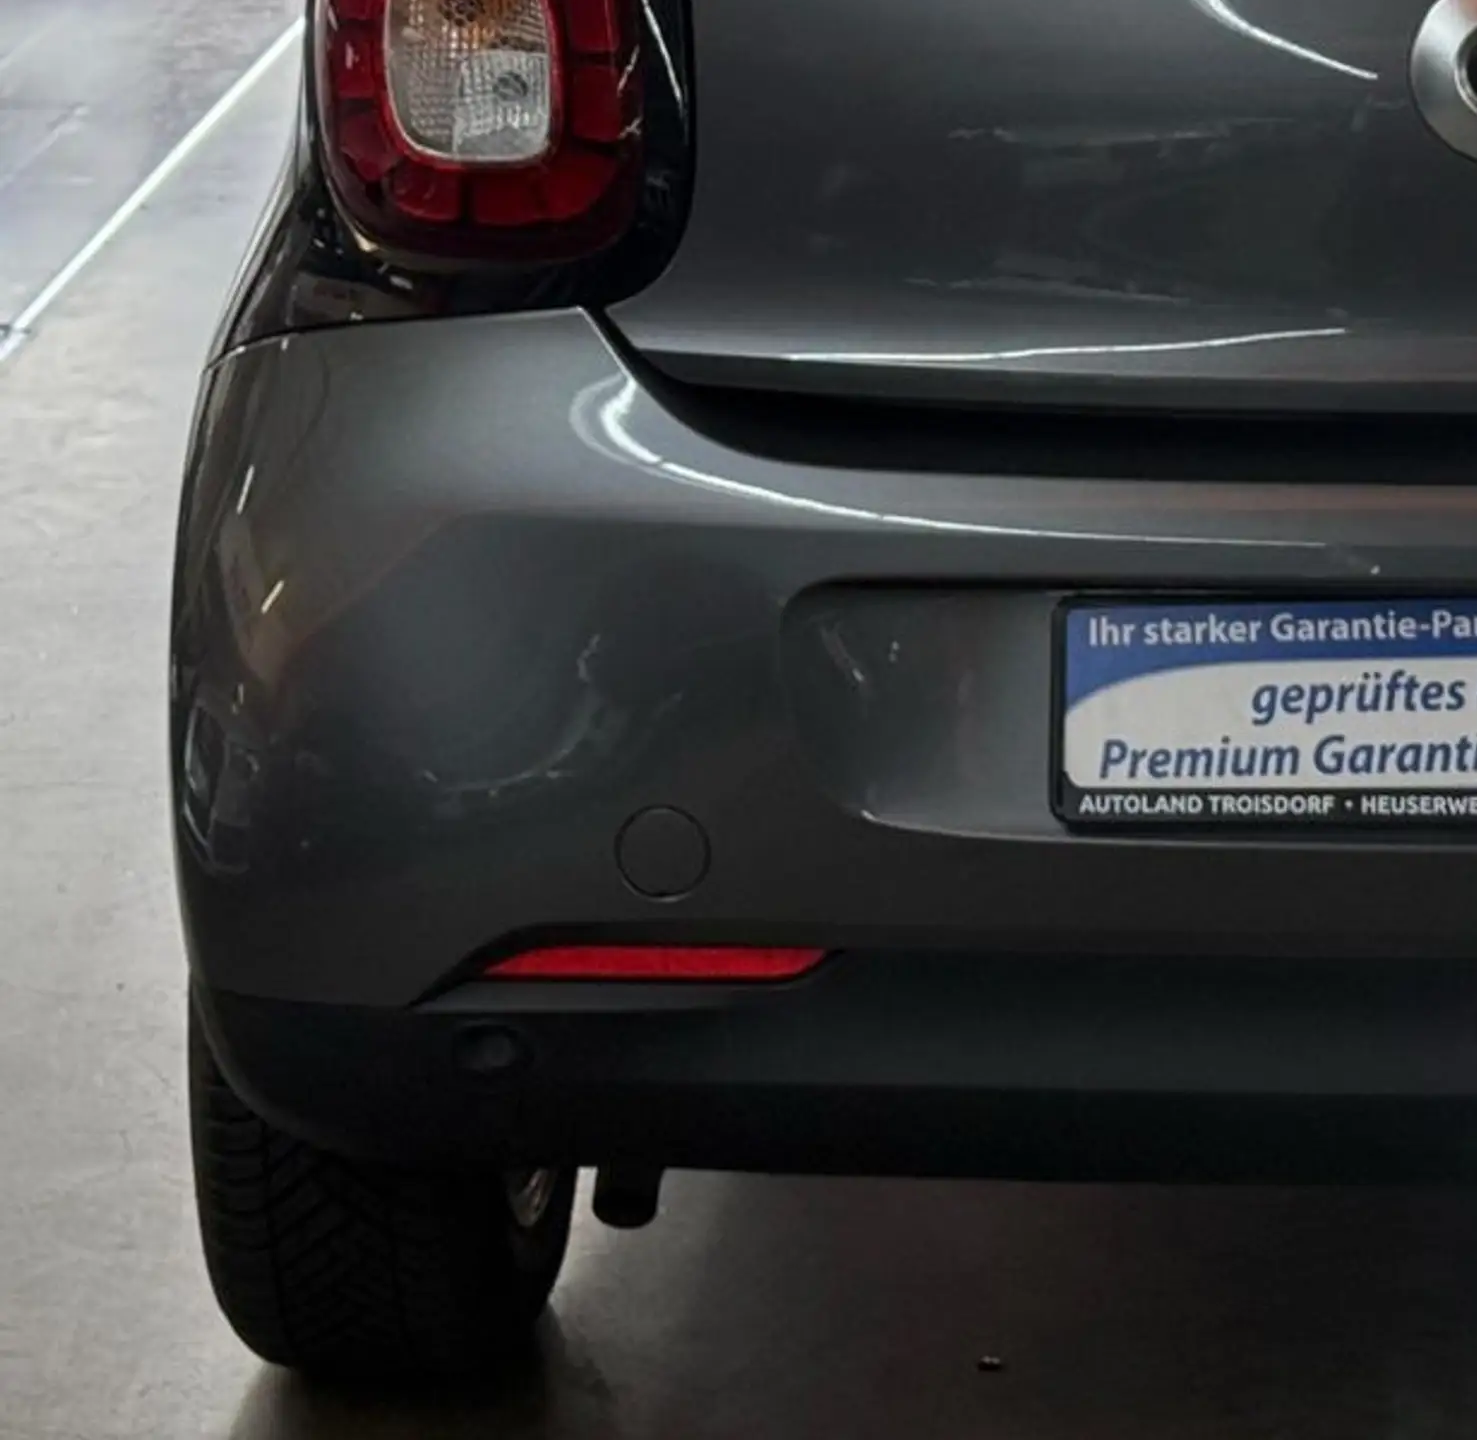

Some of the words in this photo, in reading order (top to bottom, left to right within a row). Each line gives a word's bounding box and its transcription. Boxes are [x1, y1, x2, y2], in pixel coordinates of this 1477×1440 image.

[1088, 618, 1134, 647] Ihr
[1143, 617, 1261, 645] starker
[1251, 669, 1466, 725] geprüftes
[1100, 736, 1299, 780] Premium
[1079, 794, 1203, 814] AUTOLAND
[1208, 794, 1334, 814] TROISDORF
